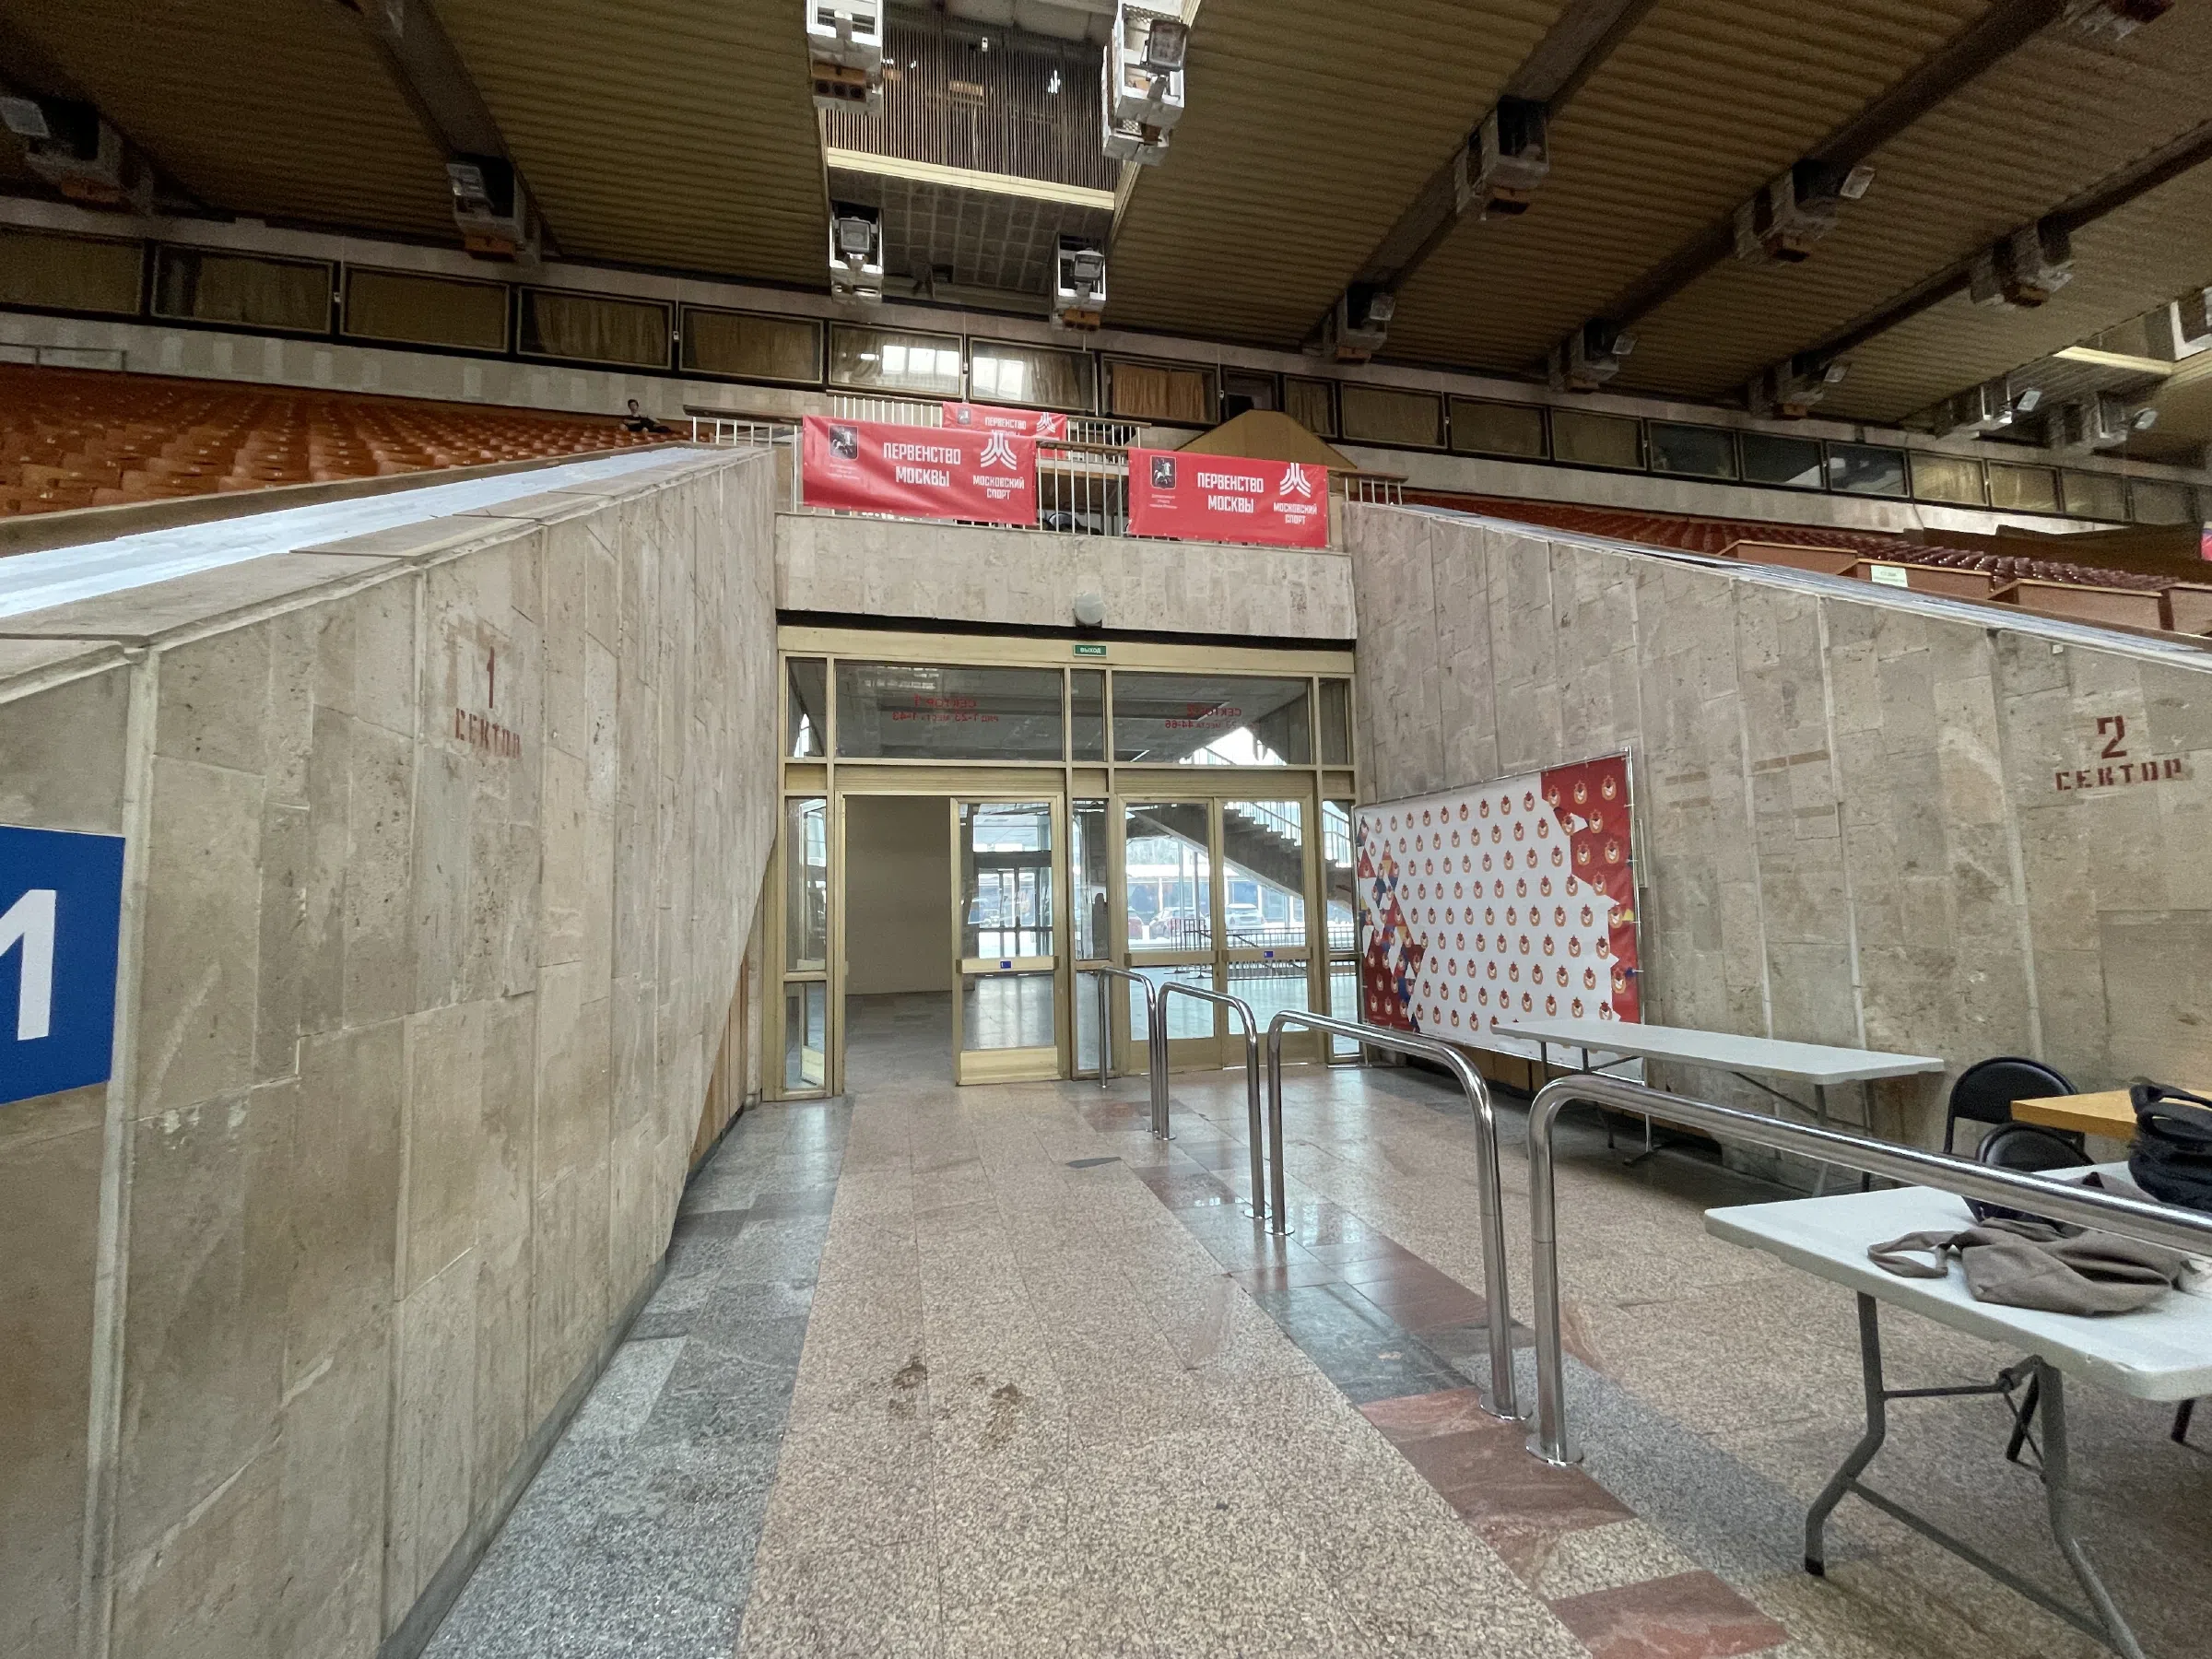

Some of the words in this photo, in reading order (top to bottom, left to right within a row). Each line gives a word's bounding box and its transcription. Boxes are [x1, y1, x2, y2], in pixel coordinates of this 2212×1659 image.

[984, 417, 1027, 430] ПЕРВЕНСТВО
[883, 441, 961, 465] ПЕРВЕНСТВО
[895, 466, 950, 488] МОСКВЫ
[972, 475, 1025, 489] МОСКОВСКИЙ
[1197, 472, 1265, 493] ПЕРВЕНСТВО
[986, 488, 1011, 500] СПОРТ
[1207, 495, 1254, 513] МОСКВЫ
[1273, 502, 1318, 515] МОСКОВСКИЙ
[1285, 514, 1306, 525] СПОРТ
[486, 646, 495, 709] 1
[454, 708, 522, 759] СЕКТОР
[2096, 714, 2127, 759] 2
[2055, 759, 2182, 791] СЕКТОР
